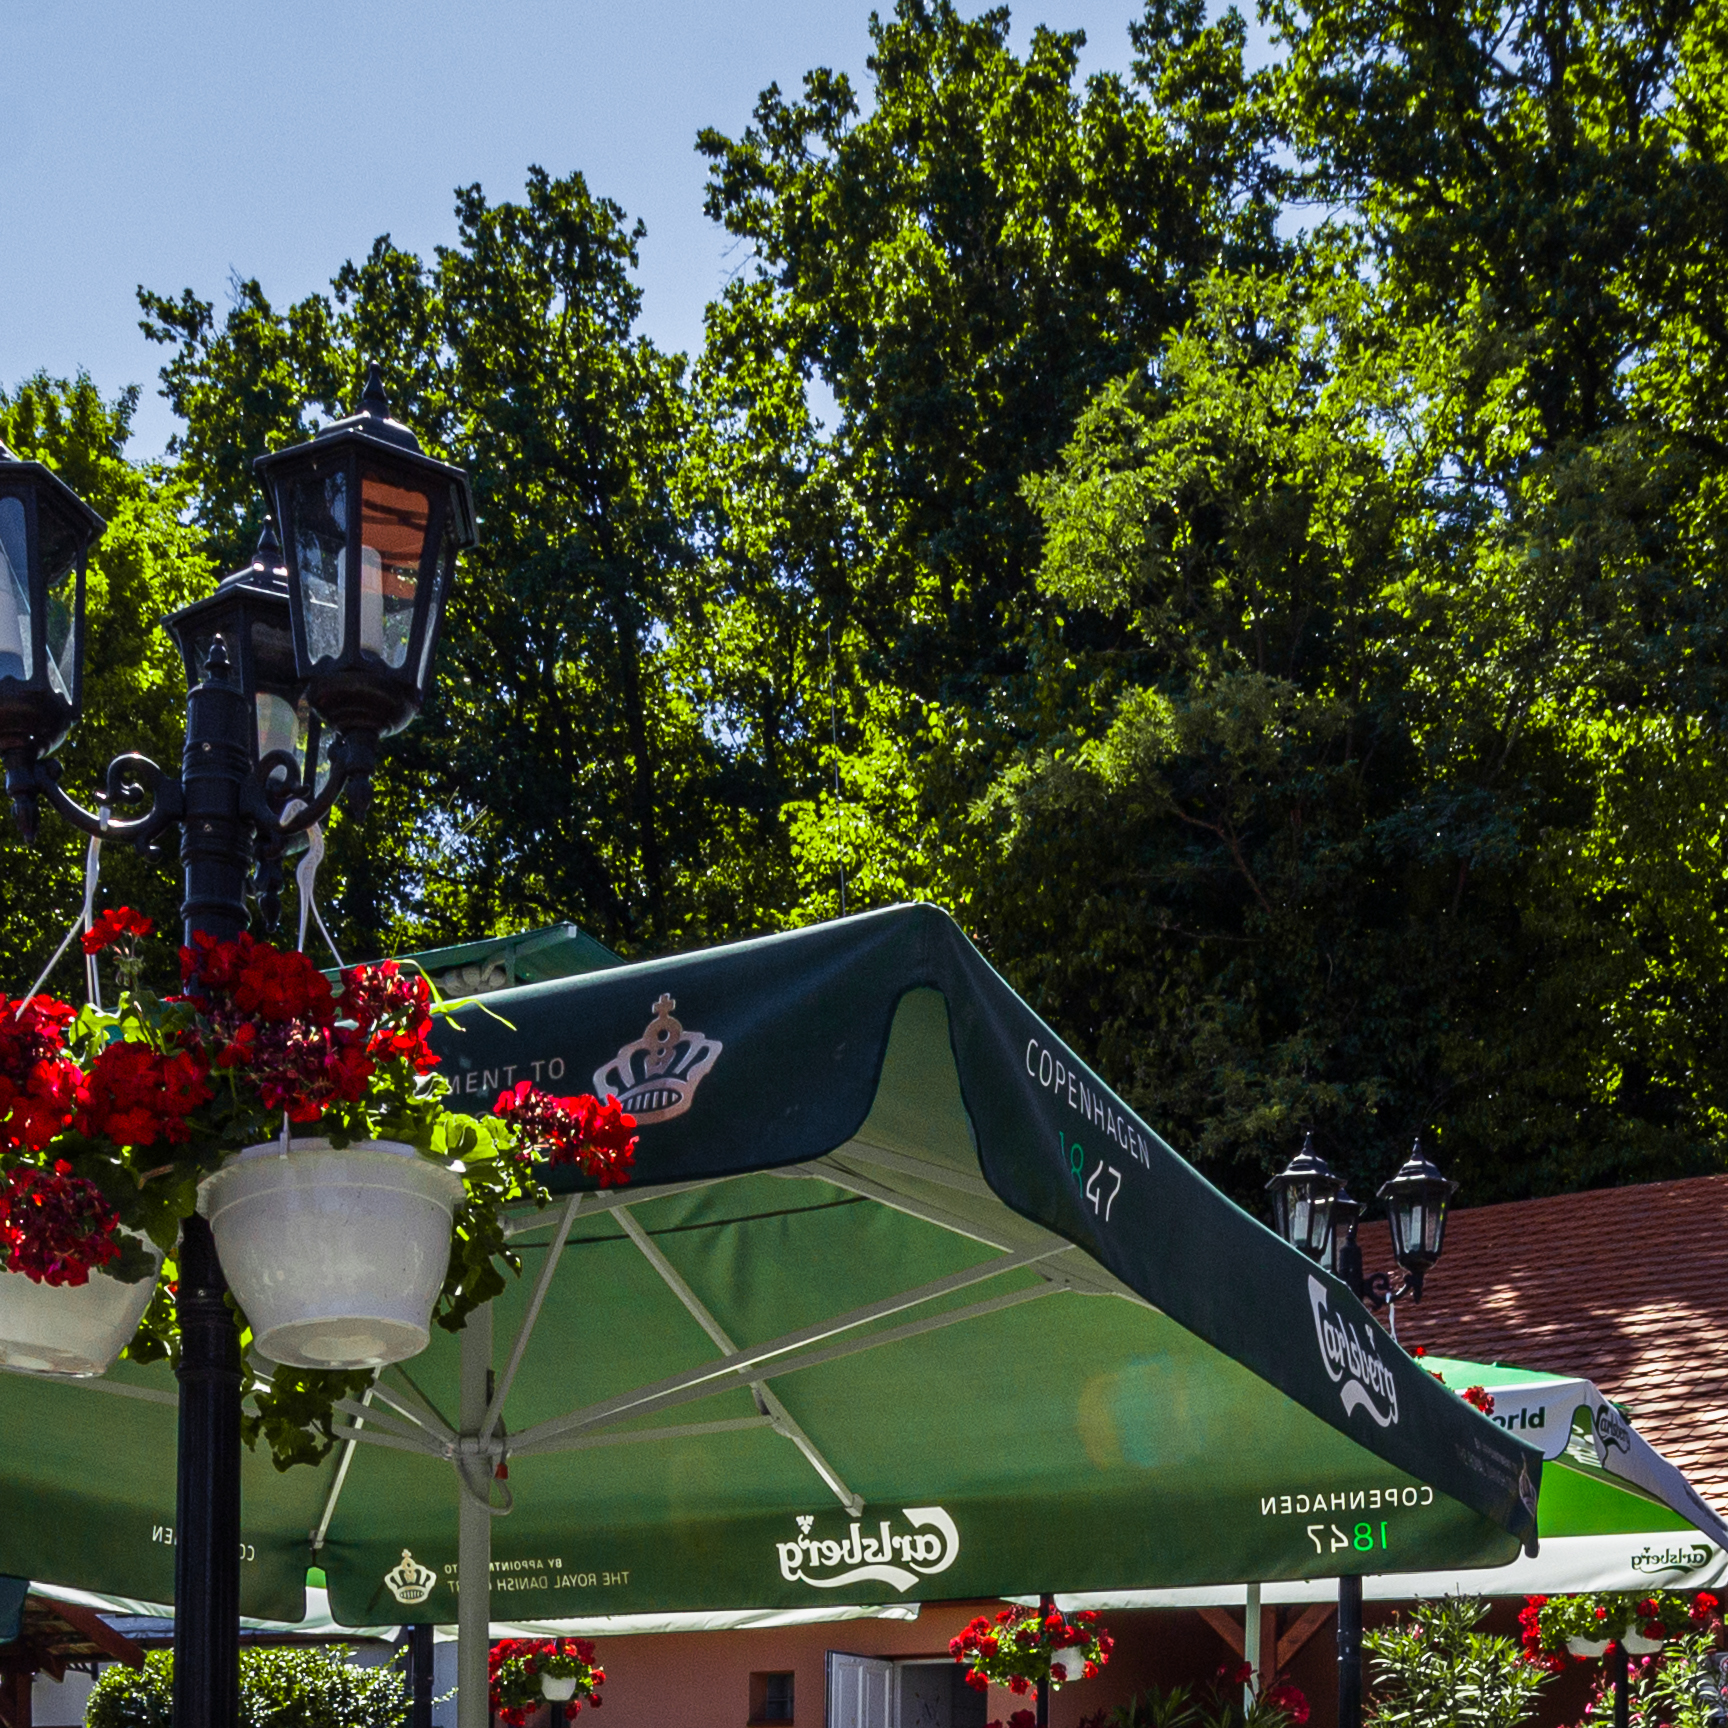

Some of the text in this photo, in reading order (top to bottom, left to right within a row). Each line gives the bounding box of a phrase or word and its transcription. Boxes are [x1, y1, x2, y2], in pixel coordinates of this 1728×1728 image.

[530, 1057, 565, 1083] TO
[1026, 1038, 1150, 1170] COPENHAGEN
[1058, 1130, 1122, 1222] 1847
[1307, 1273, 1399, 1428] Carlsberg
